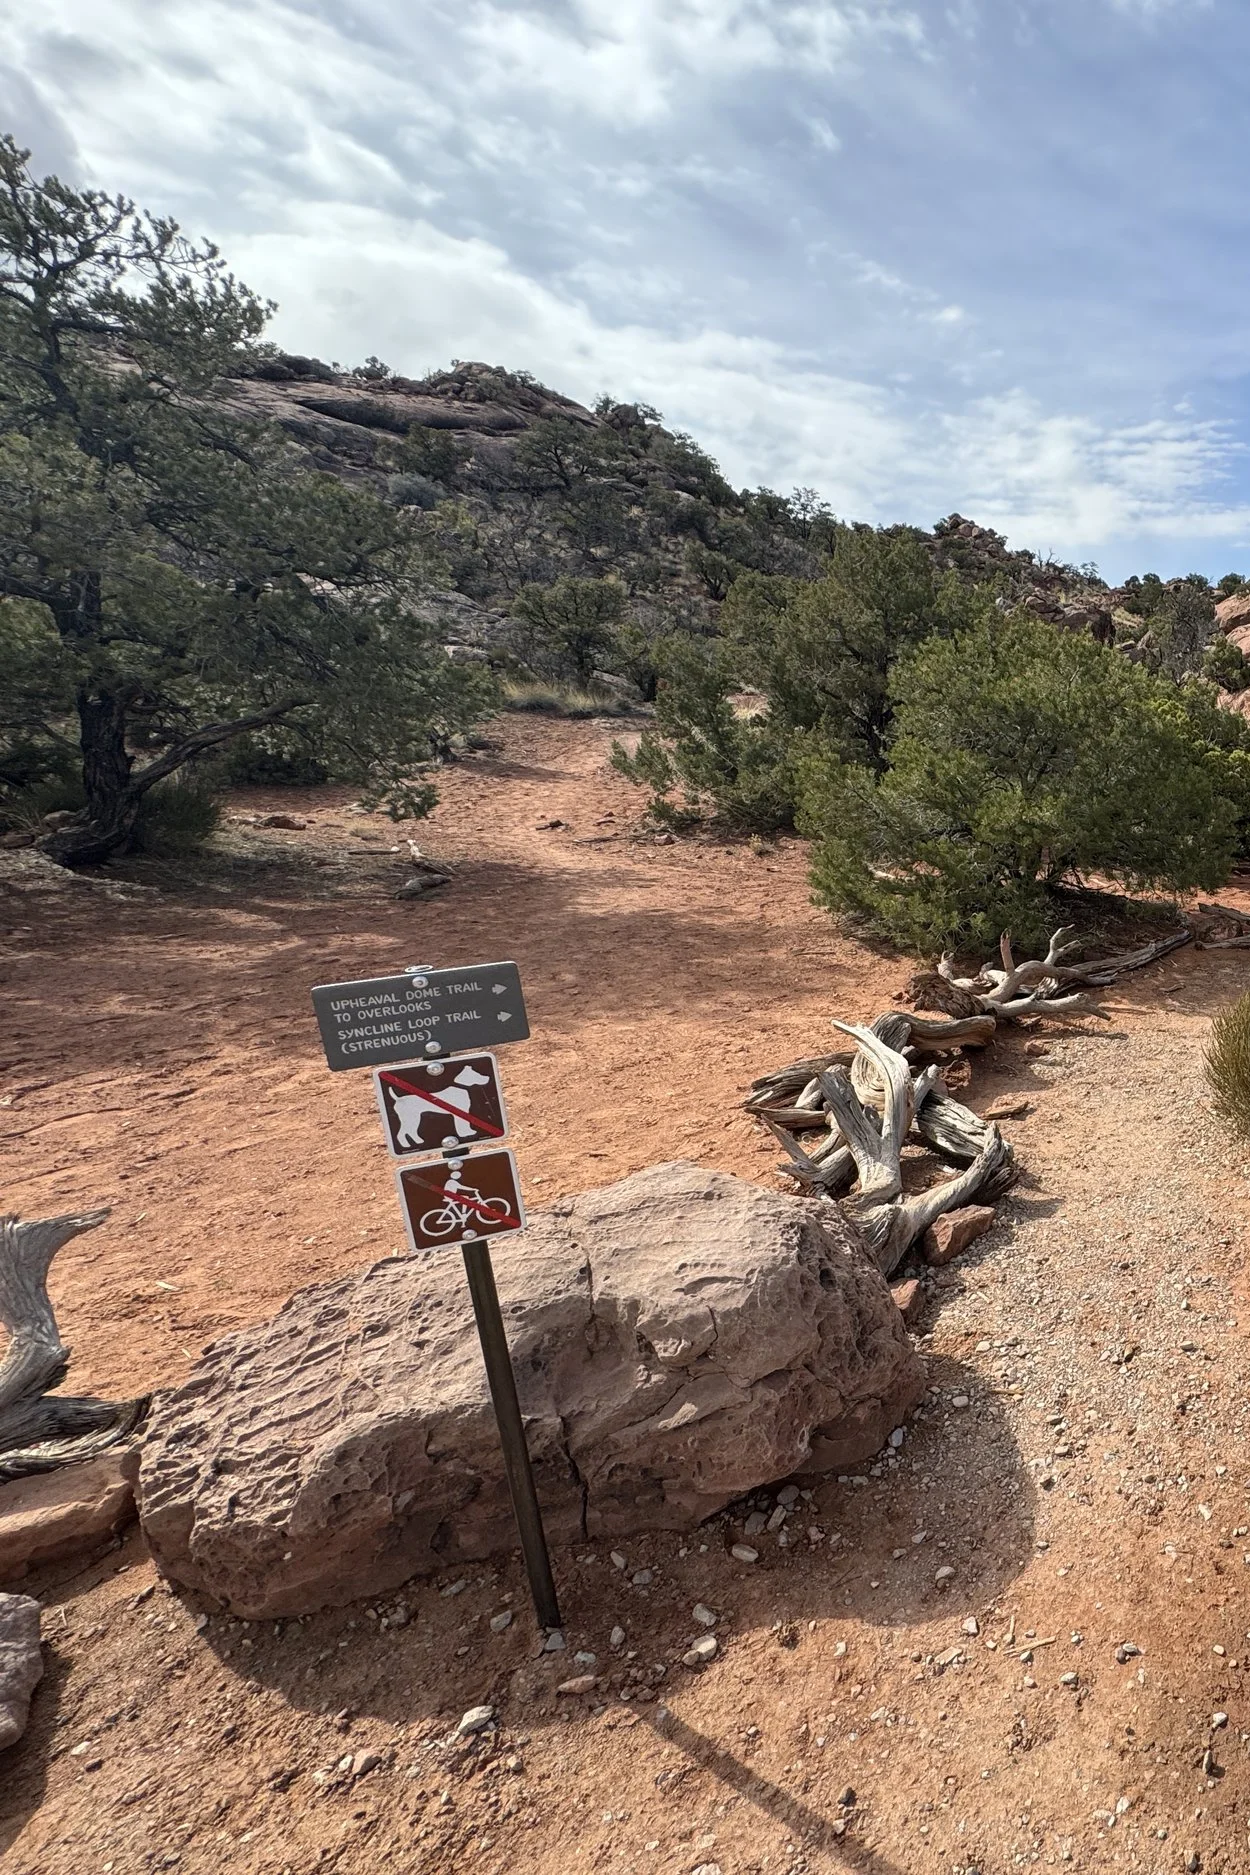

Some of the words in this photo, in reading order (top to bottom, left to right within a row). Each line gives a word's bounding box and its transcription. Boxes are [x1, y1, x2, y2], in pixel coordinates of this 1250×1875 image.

[331, 994, 400, 1011] UPHEAVAL
[406, 987, 441, 1001] DOME
[447, 982, 482, 995] TRAIL
[334, 1012, 350, 1023] TO
[358, 1001, 432, 1020] OVERLOOKS
[338, 1022, 402, 1040] SYNCLINE
[408, 1016, 440, 1029] LOOP
[446, 1010, 481, 1023] TRAIL
[341, 1030, 432, 1054] (STRENUOUS)
